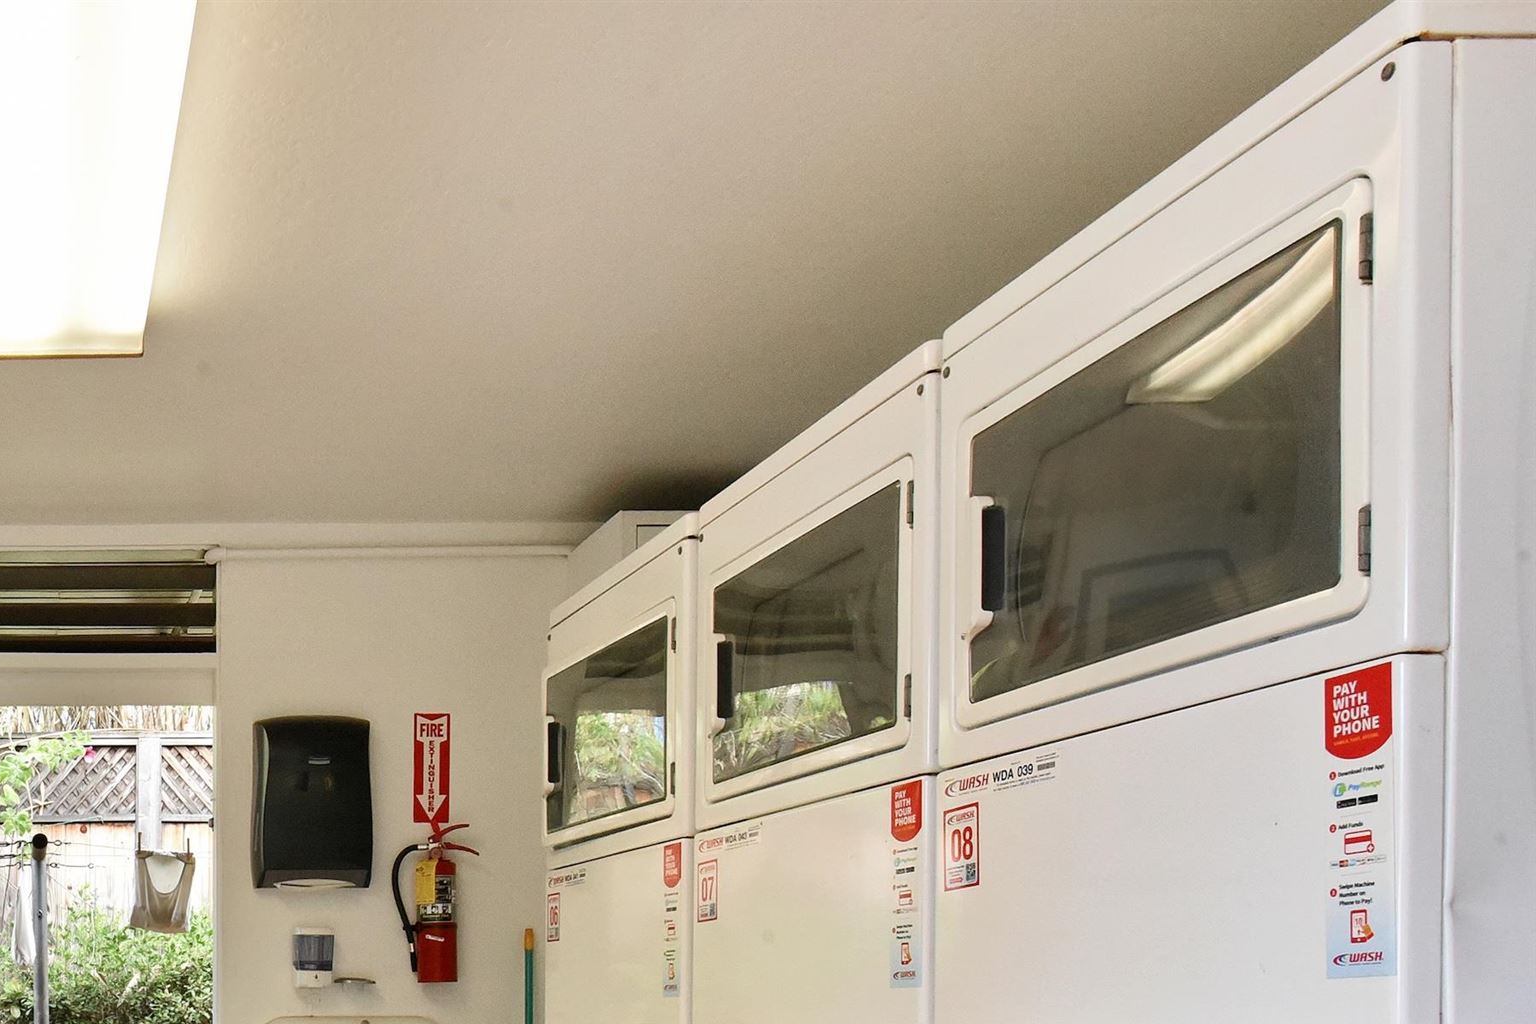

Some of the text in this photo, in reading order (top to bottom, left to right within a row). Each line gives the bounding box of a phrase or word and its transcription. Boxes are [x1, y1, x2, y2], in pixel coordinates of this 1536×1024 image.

[1333, 681, 1357, 698] PAY
[1332, 691, 1368, 711] WITH
[1332, 704, 1370, 724] YOUR
[419, 723, 444, 738] FIRE
[1333, 715, 1380, 738] PHONE
[427, 740, 435, 813] EXTINGUISHER
[958, 773, 990, 792] WASH
[992, 767, 1014, 783] WDA
[1017, 763, 1034, 777] 039
[894, 797, 912, 809] WITH
[895, 789, 907, 800] PAY
[895, 806, 912, 818] YOUR
[895, 814, 917, 827] PHONE
[951, 826, 974, 863] 08
[701, 876, 714, 902] 07
[550, 905, 559, 927] 06
[1349, 951, 1384, 963] WASH
